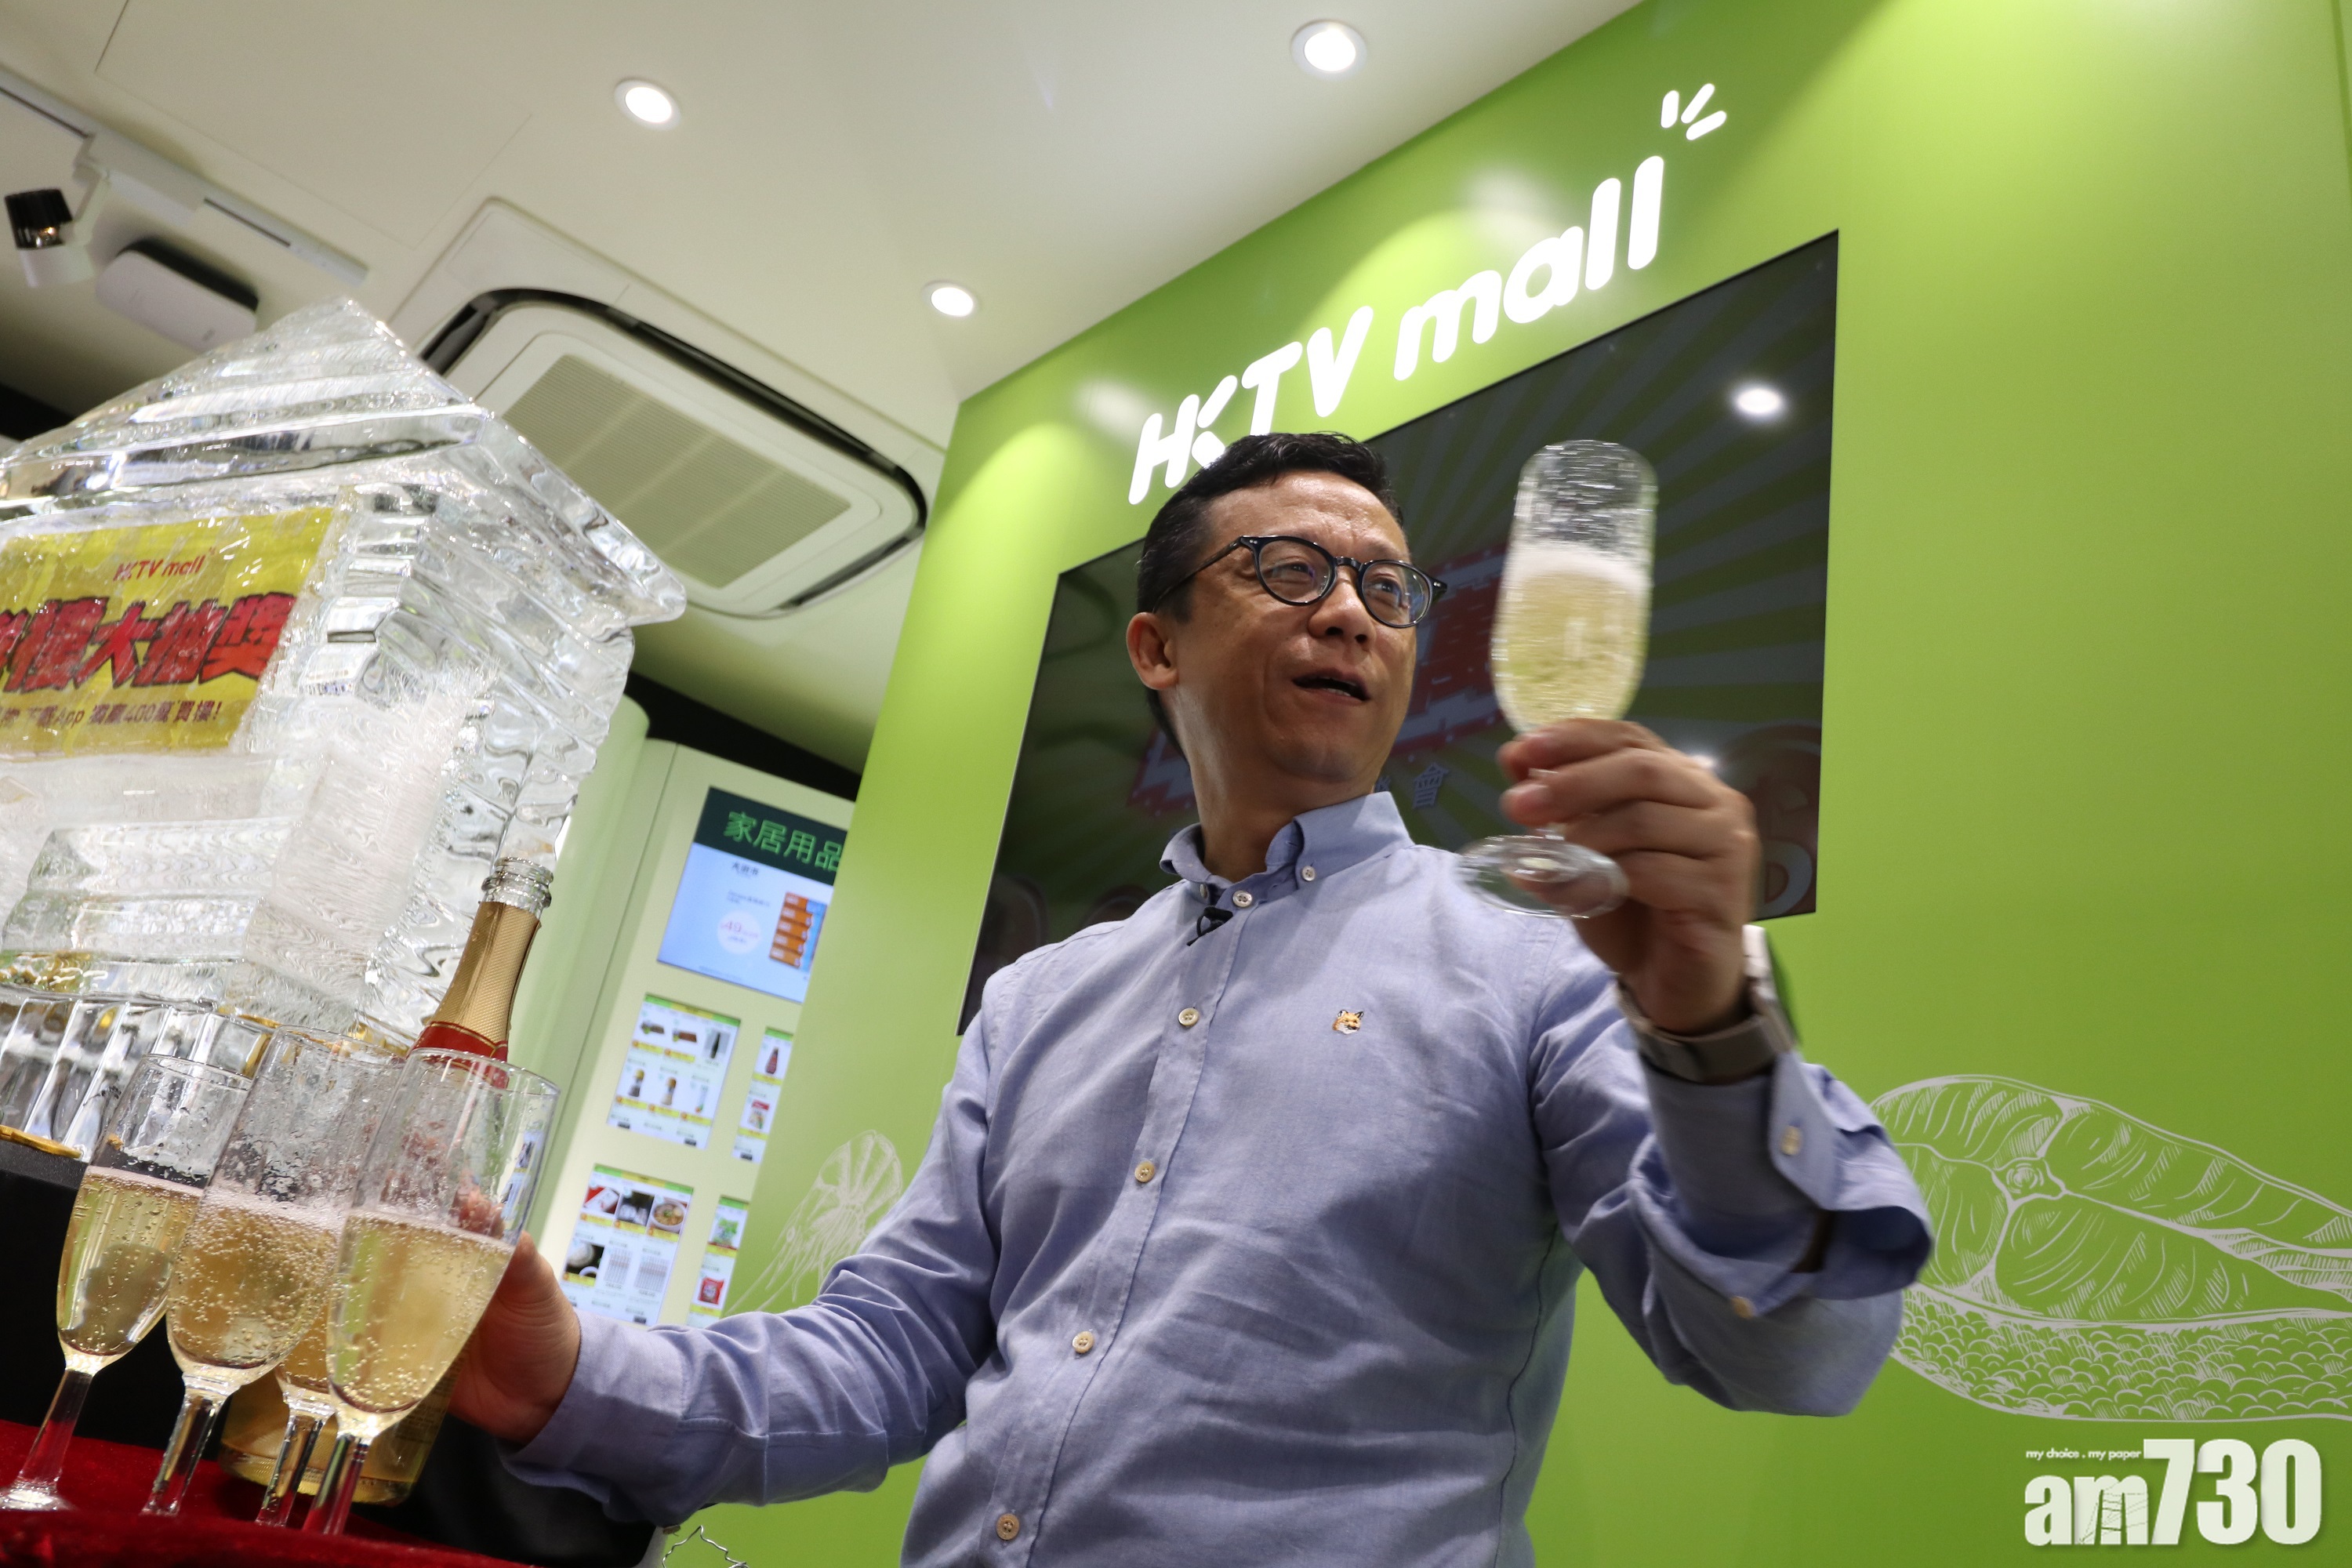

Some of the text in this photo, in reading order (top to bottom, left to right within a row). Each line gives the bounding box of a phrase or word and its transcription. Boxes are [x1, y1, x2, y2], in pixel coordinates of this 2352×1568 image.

[1127, 155, 1664, 505] HKTV mall
[162, 554, 205, 577] mall
[723, 811, 843, 873] 家居用品
